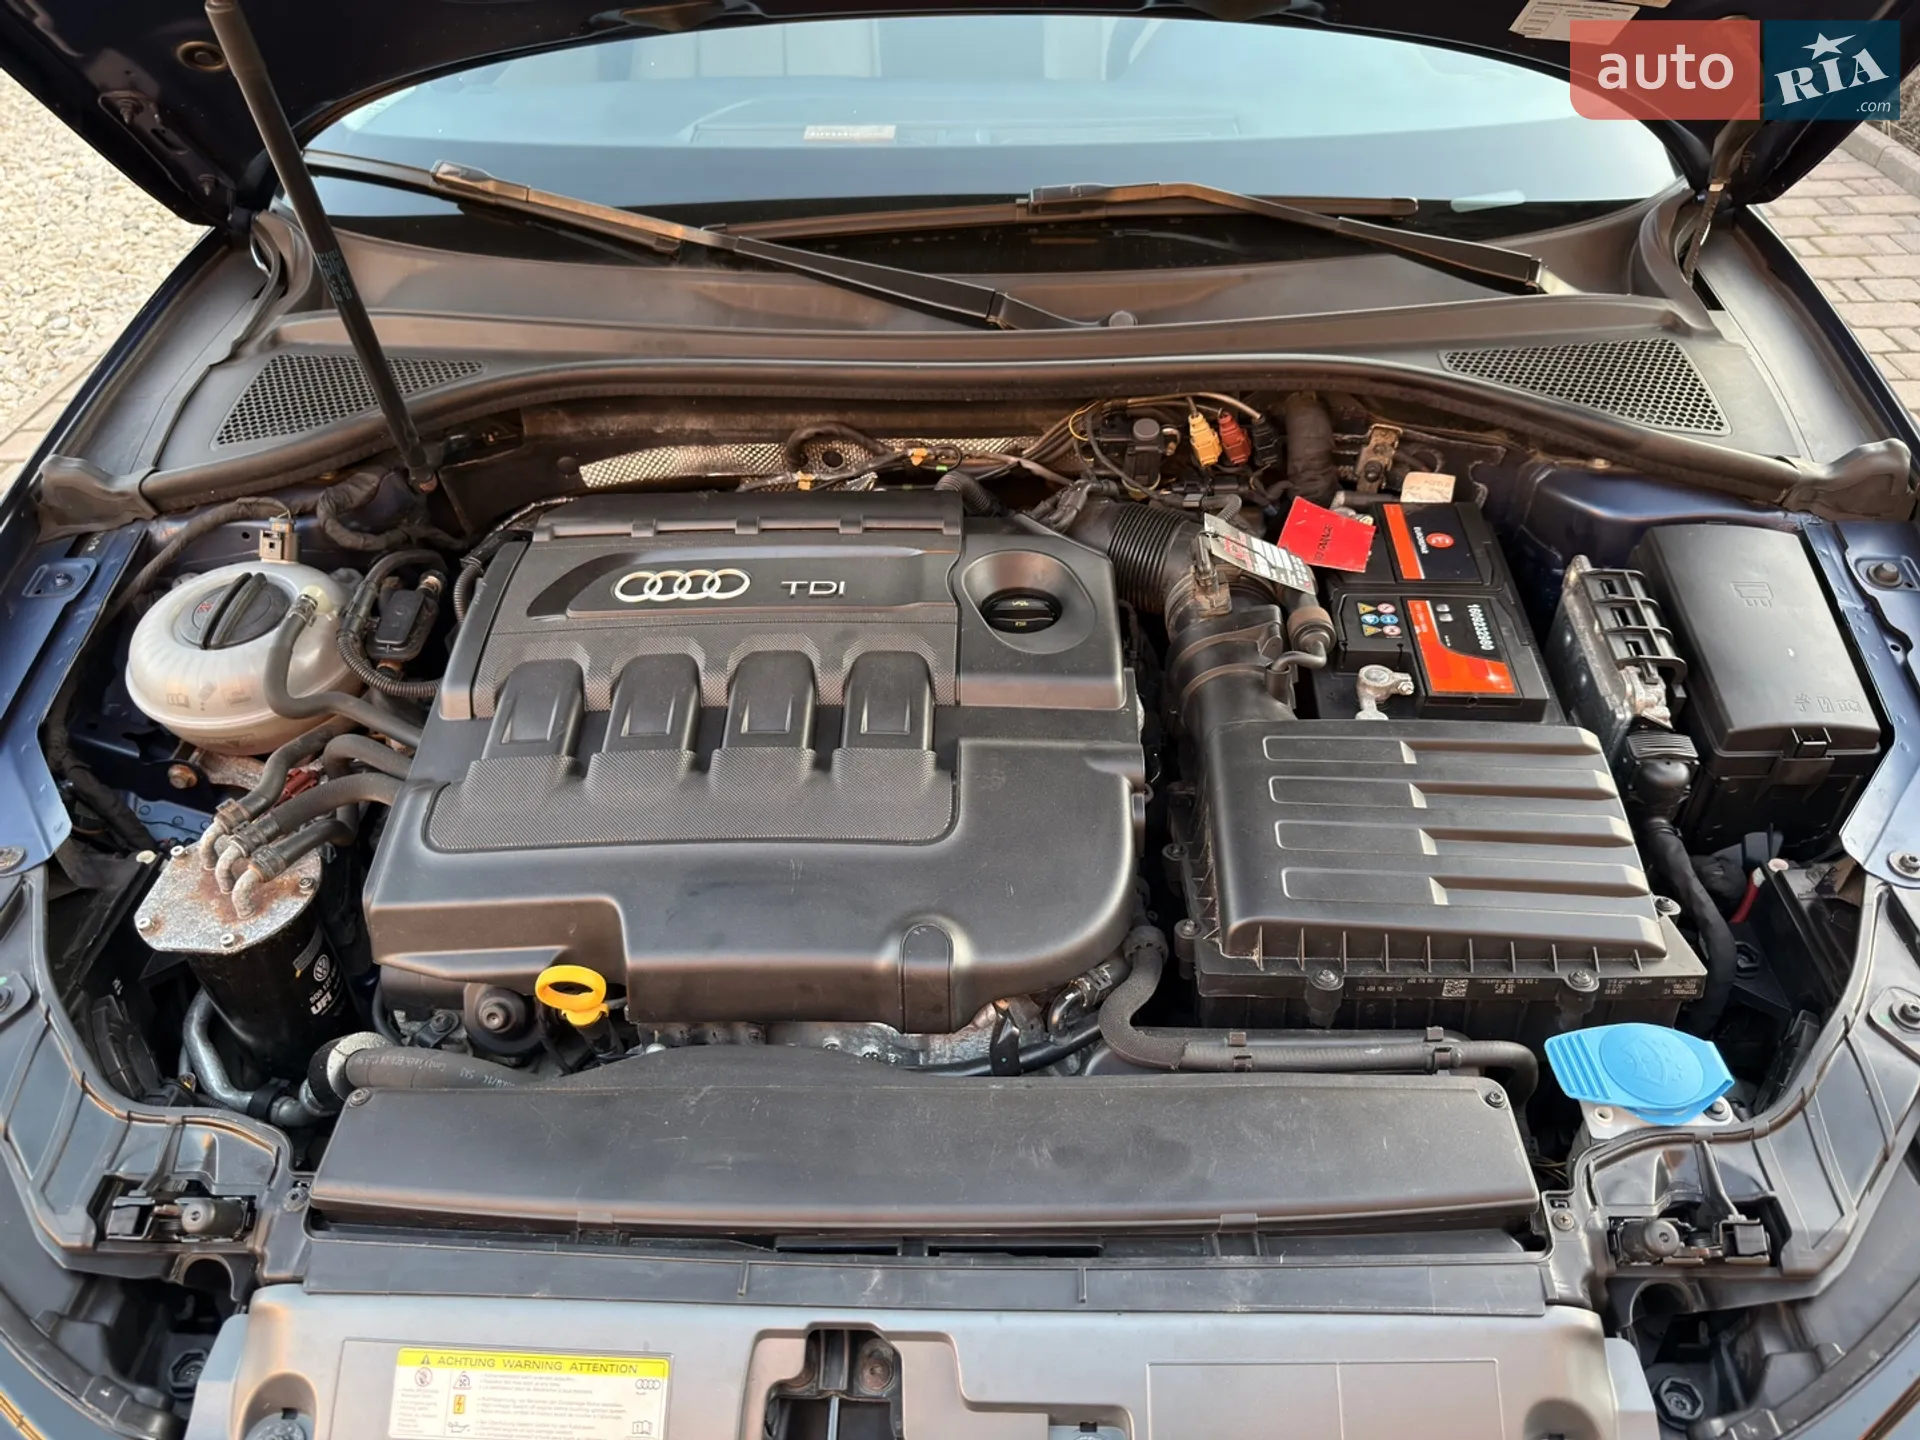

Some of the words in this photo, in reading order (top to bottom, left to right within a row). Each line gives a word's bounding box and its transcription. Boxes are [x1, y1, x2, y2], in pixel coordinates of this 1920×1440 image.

[781, 580, 847, 597] TDI
[437, 1356, 496, 1368] ACHTUNG
[503, 1359, 563, 1371] WARNING
[569, 1363, 638, 1374] ATTENTION
